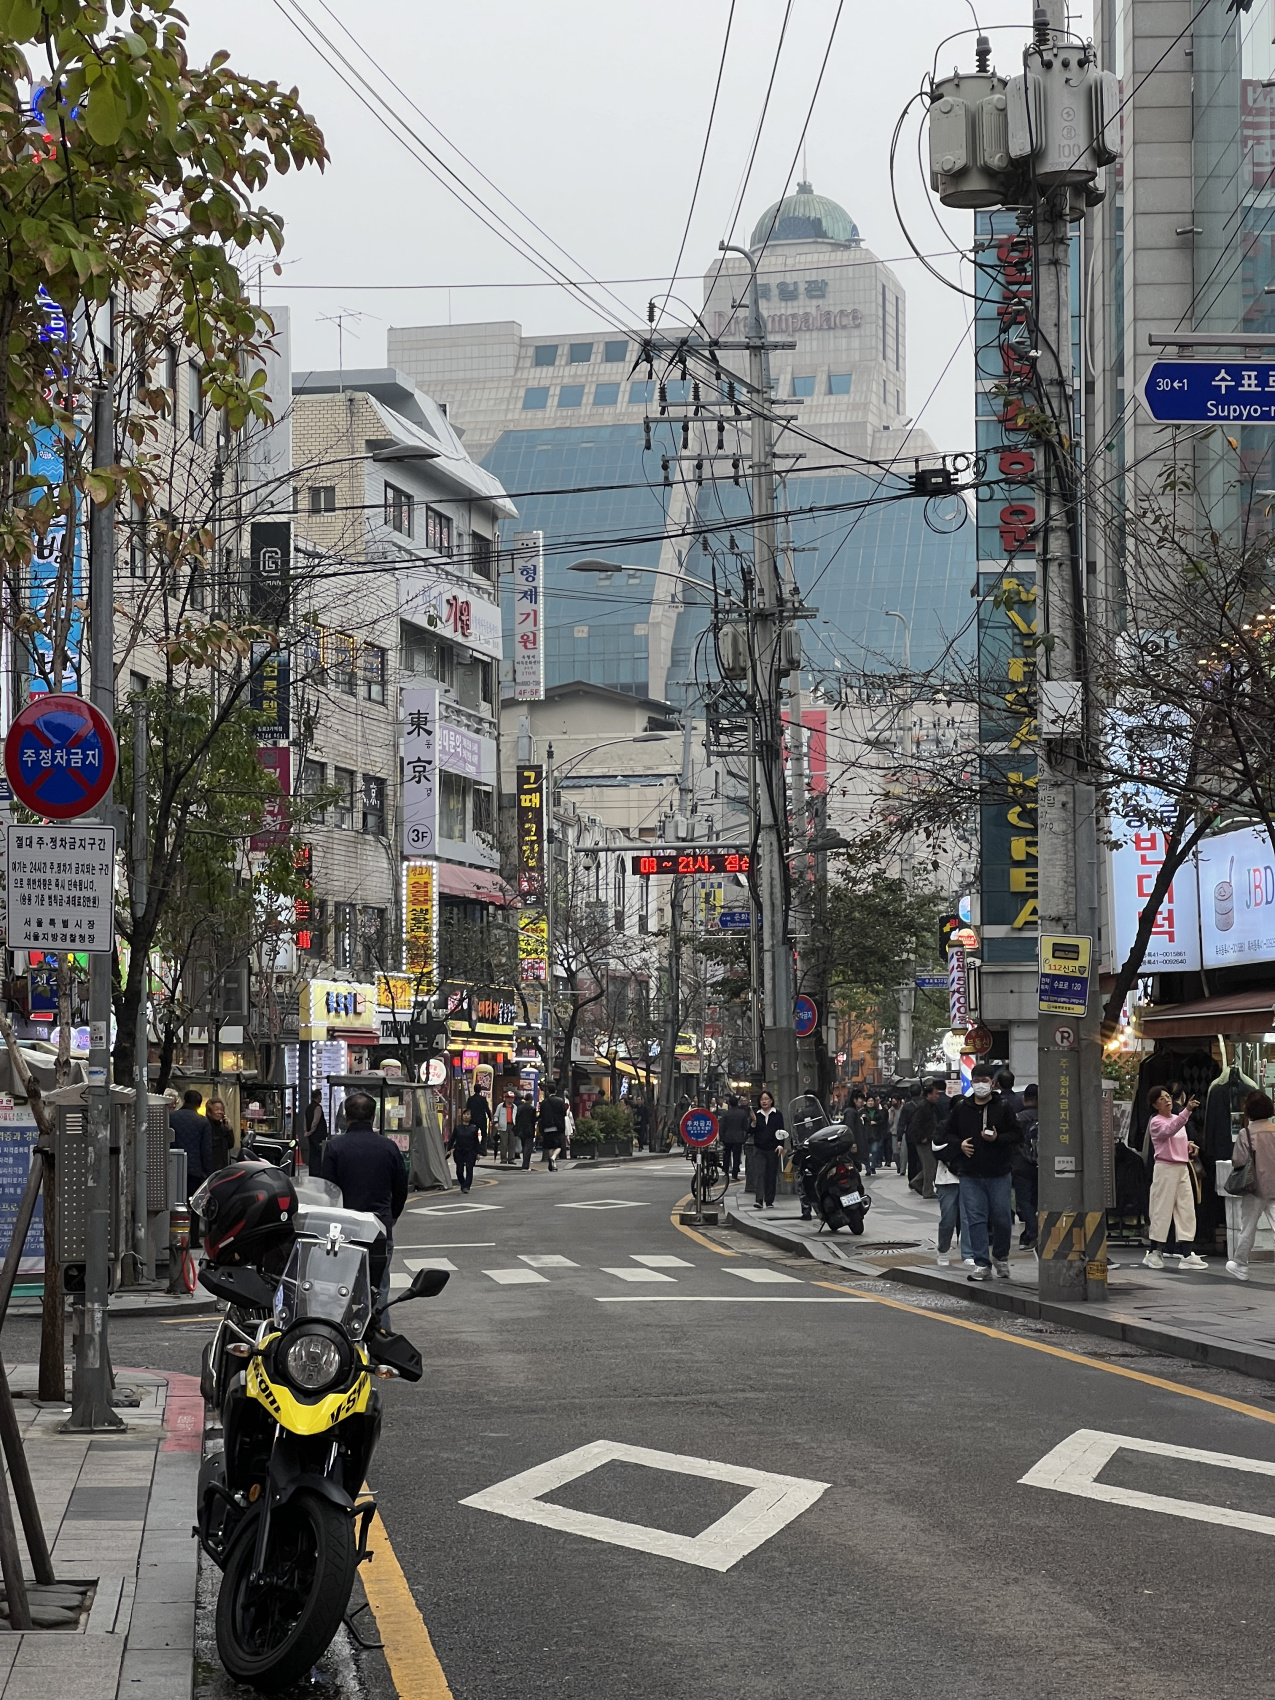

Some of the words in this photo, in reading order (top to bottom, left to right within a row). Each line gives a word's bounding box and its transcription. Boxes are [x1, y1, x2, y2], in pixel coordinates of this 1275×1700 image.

[714, 304, 864, 337] Drempalace
[445, 594, 473, 638] 기원
[22, 748, 99, 767] 주정차금지
[16, 836, 32, 848] 절대
[411, 829, 428, 842] 3F
[1048, 963, 1077, 973] 112신고
